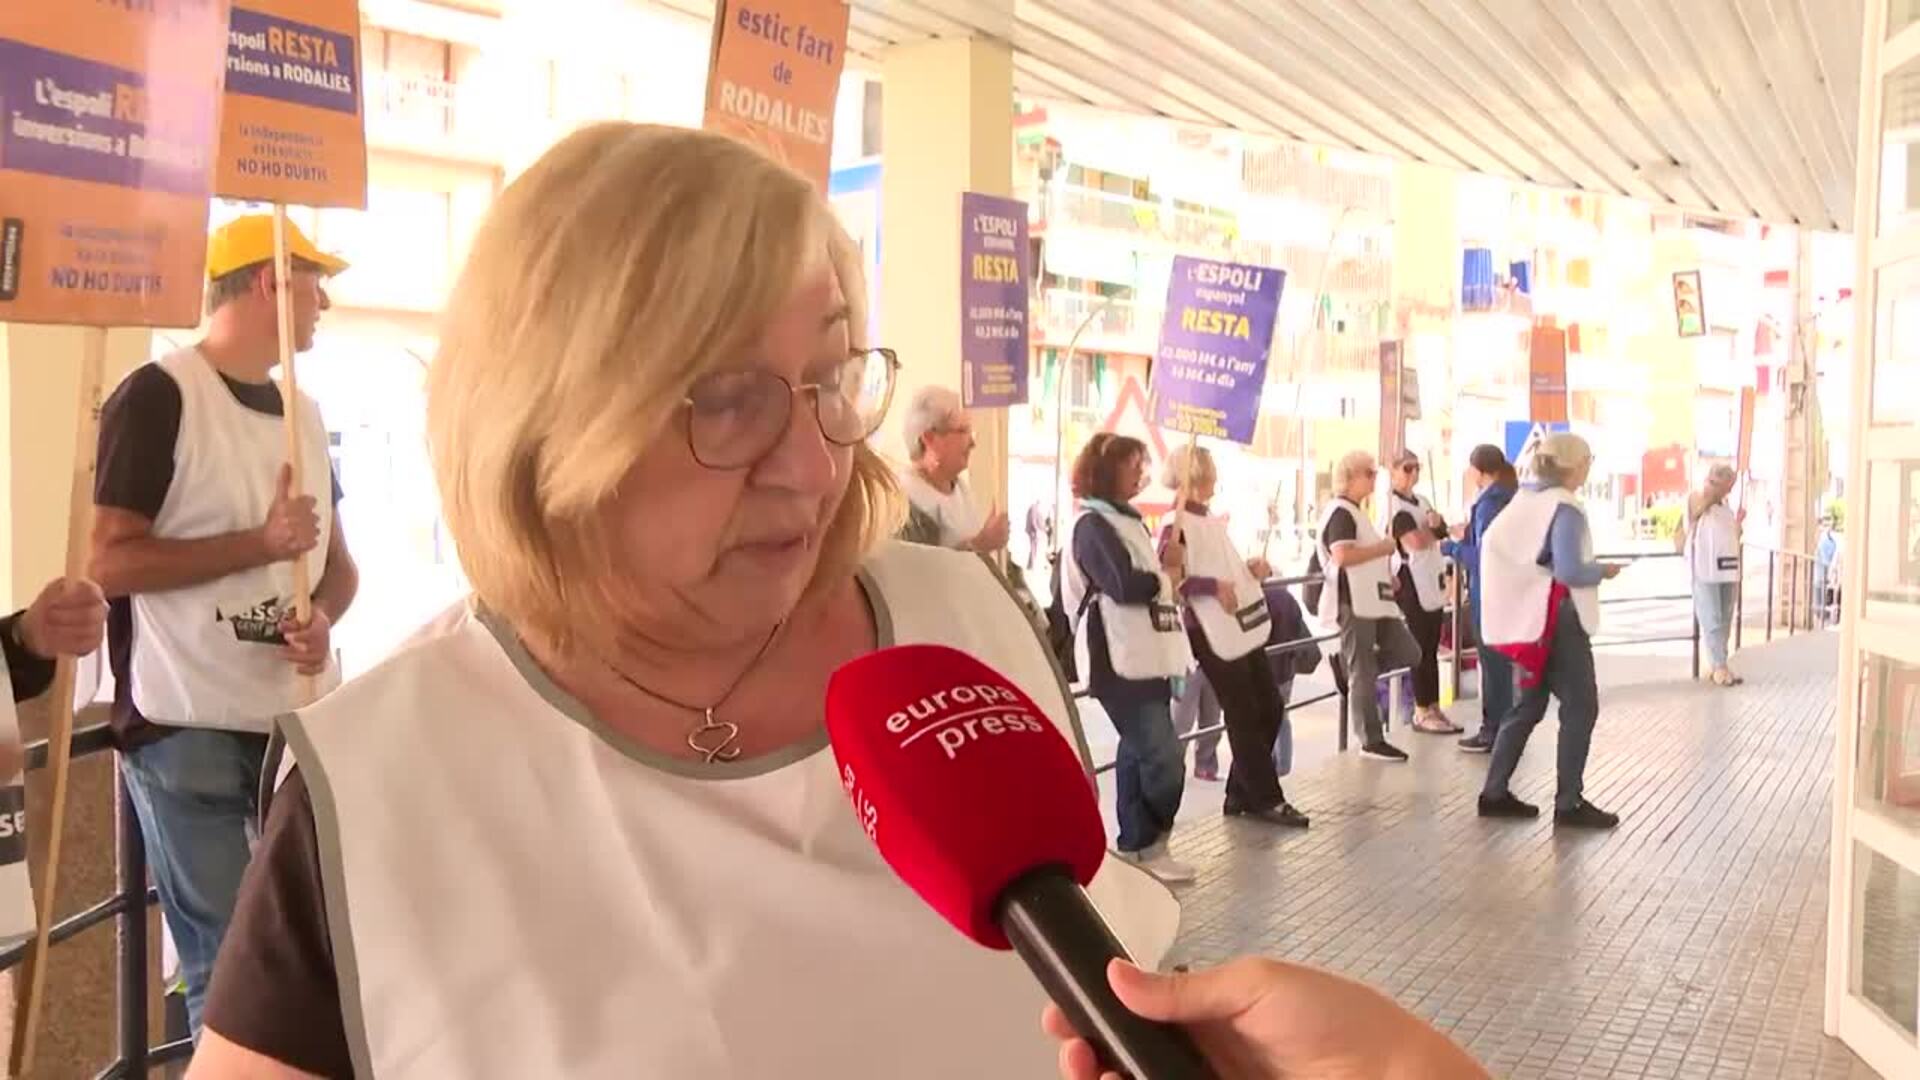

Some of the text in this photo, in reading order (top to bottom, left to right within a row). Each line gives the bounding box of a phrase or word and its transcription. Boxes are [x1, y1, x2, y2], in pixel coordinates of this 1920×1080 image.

[228, 26, 337, 67] spoli RESTA
[737, 8, 834, 65] estic fart
[227, 55, 352, 92] rsions a RODALIES
[773, 60, 793, 85] de
[720, 80, 828, 144] RODALIES
[237, 158, 258, 174] NO
[261, 160, 281, 177] HO
[51, 266, 78, 289] NO
[83, 269, 109, 291] HO
[972, 254, 1019, 284] RESTA
[1187, 263, 1264, 292] L'ESPOLI
[1181, 306, 1250, 340] RESTA
[886, 684, 1020, 734] europa
[935, 713, 1044, 760] press
